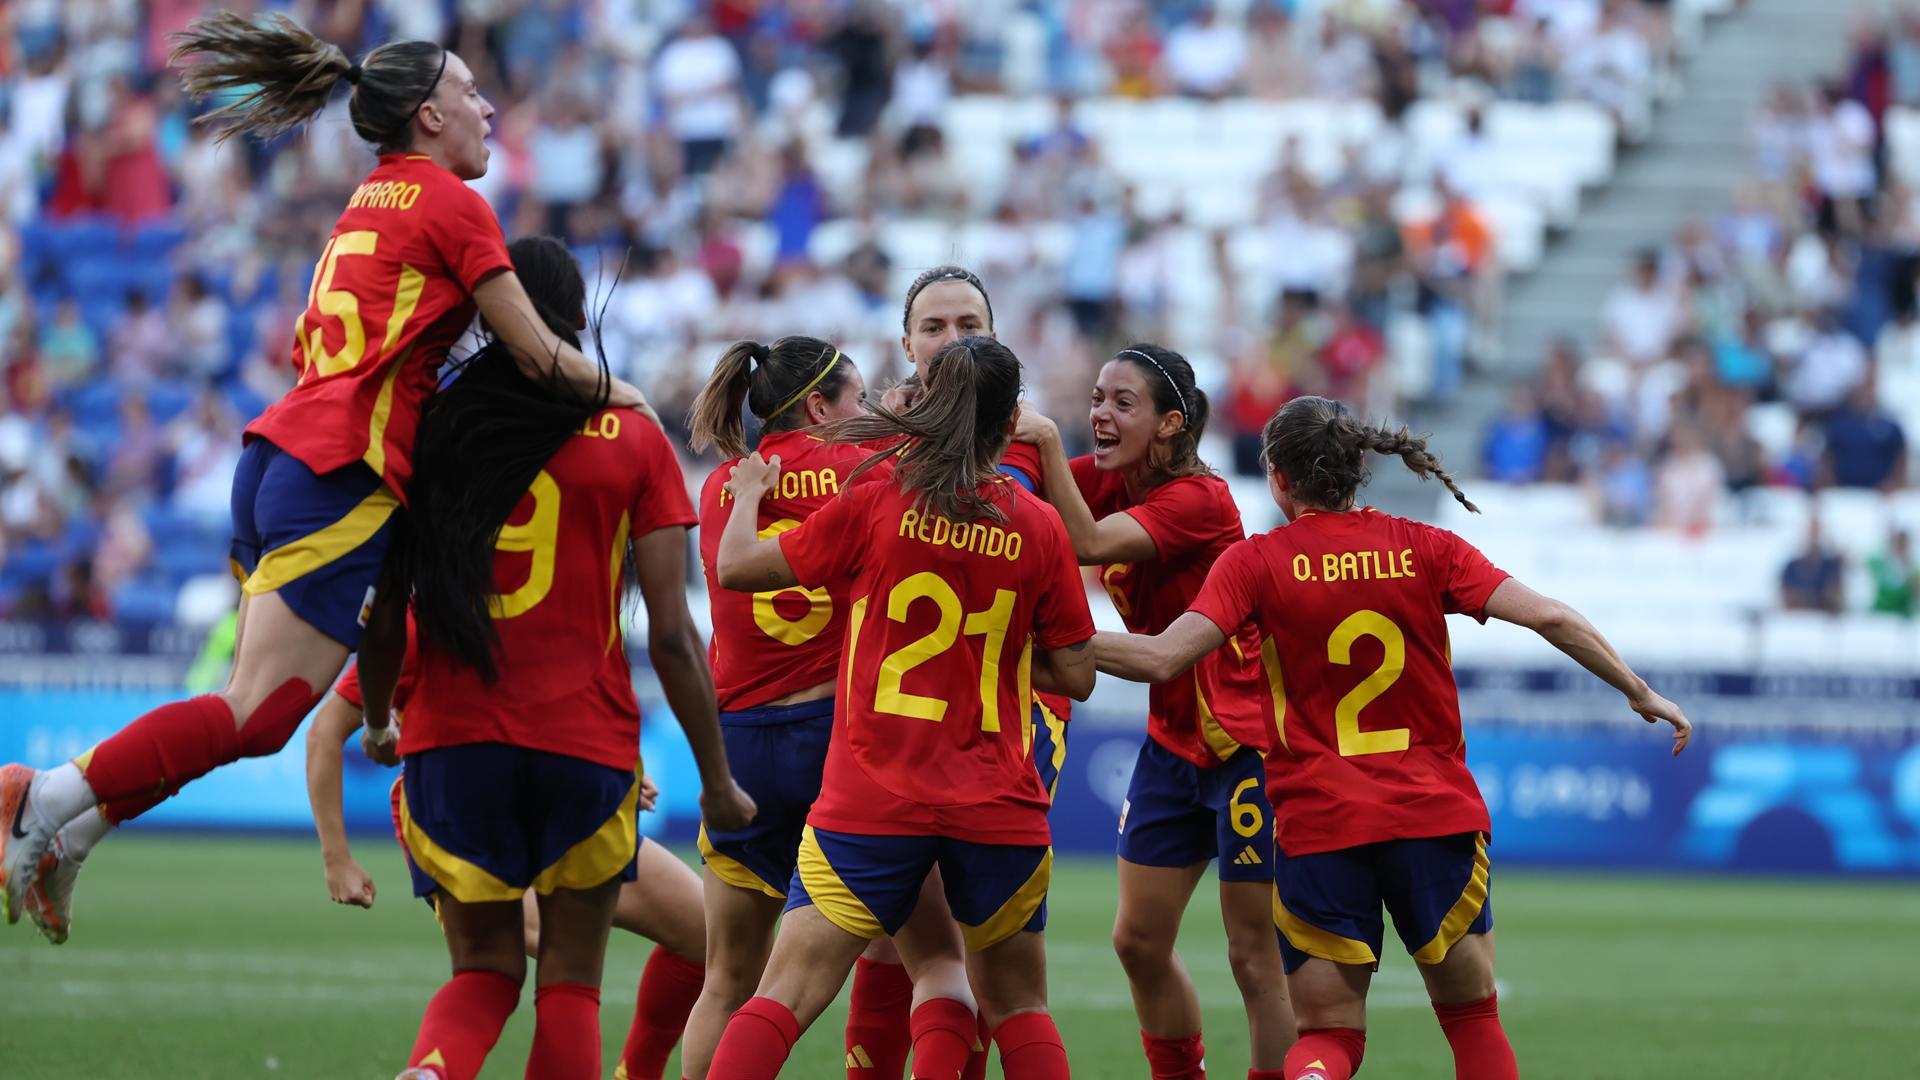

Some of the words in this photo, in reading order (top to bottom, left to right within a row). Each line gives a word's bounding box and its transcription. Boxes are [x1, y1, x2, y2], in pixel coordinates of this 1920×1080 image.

[488, 467, 561, 619] 9
[899, 508, 1023, 562] REDONDO
[1292, 553, 1318, 582] O.
[1322, 548, 1417, 582] BATLLE
[874, 571, 1017, 733] 21
[1327, 609, 1410, 757] 2
[1230, 777, 1264, 838] 6
